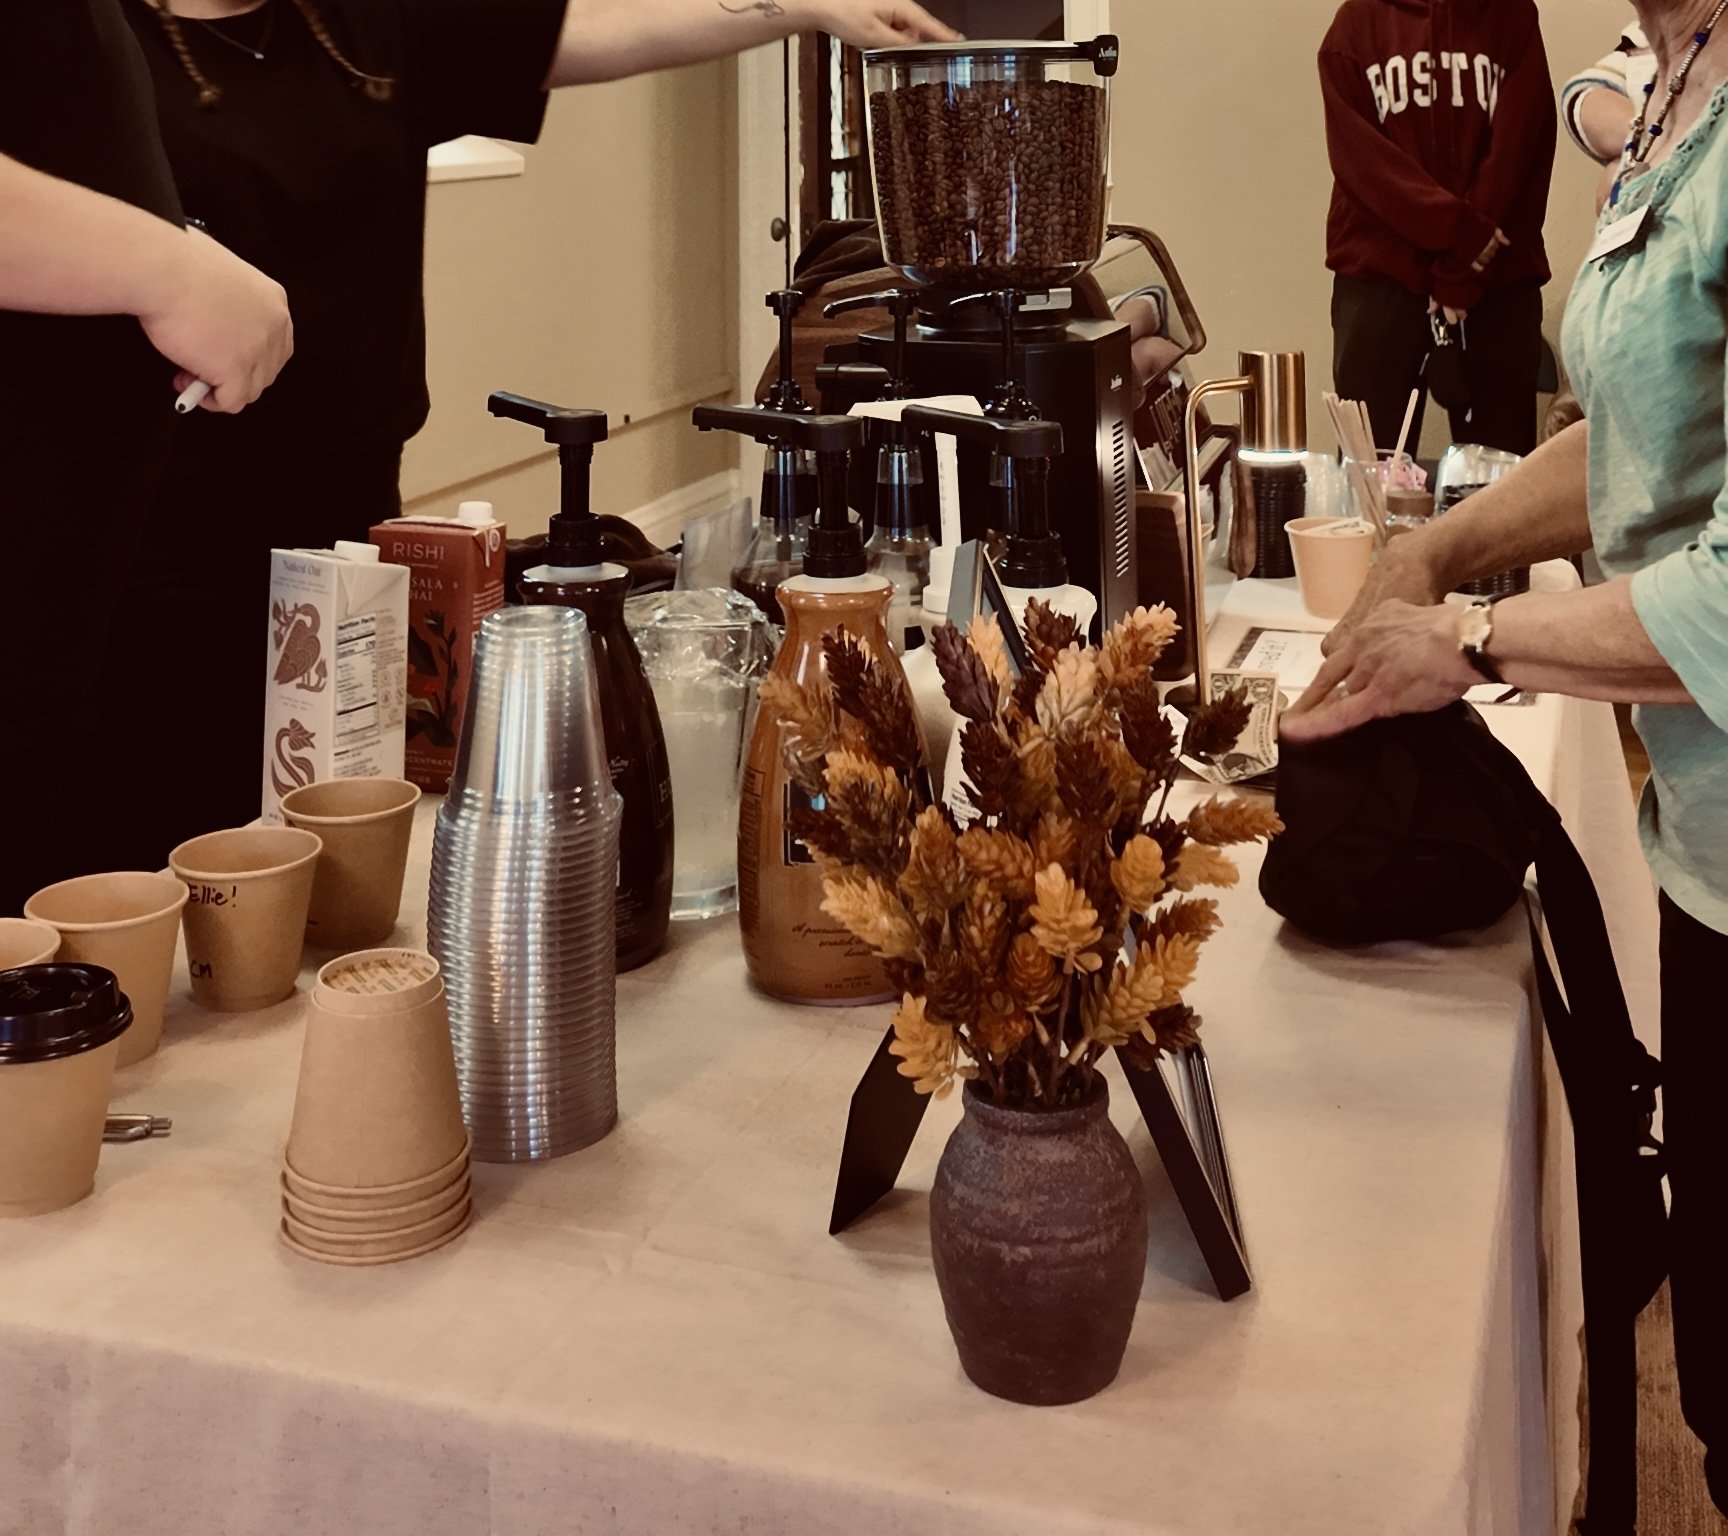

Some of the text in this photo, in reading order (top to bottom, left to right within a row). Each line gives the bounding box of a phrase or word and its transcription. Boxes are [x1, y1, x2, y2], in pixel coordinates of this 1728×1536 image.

[392, 542, 445, 561] RISHI
[411, 576, 443, 590] SALA
[409, 589, 433, 601] HAI
[188, 883, 237, 908] Ellie!
